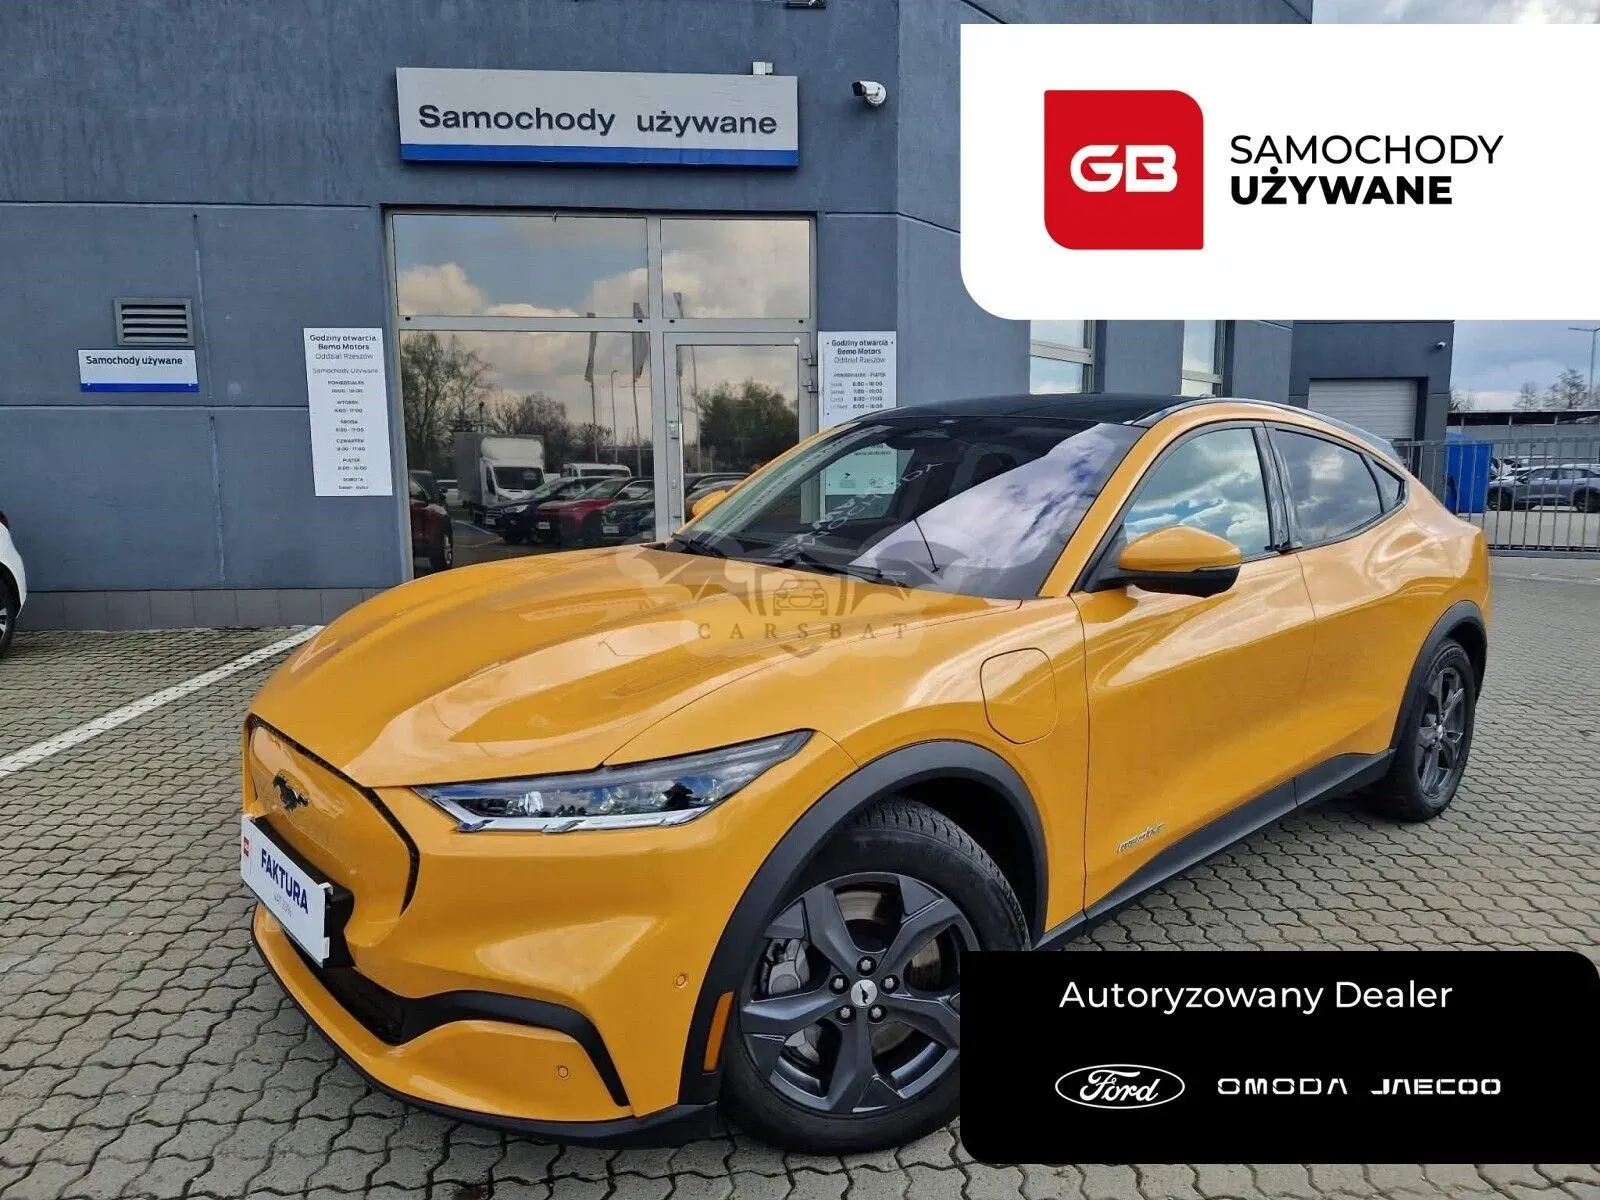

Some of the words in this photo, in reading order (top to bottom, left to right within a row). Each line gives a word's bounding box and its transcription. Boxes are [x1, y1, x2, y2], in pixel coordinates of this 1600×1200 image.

[418, 104, 616, 136] Samochody
[636, 110, 777, 138] używane
[309, 334, 342, 343] Godziny
[831, 339, 858, 347] Godziny
[86, 356, 140, 366] Samochody
[142, 356, 183, 366] używane
[260, 847, 309, 914] FAKTURA
